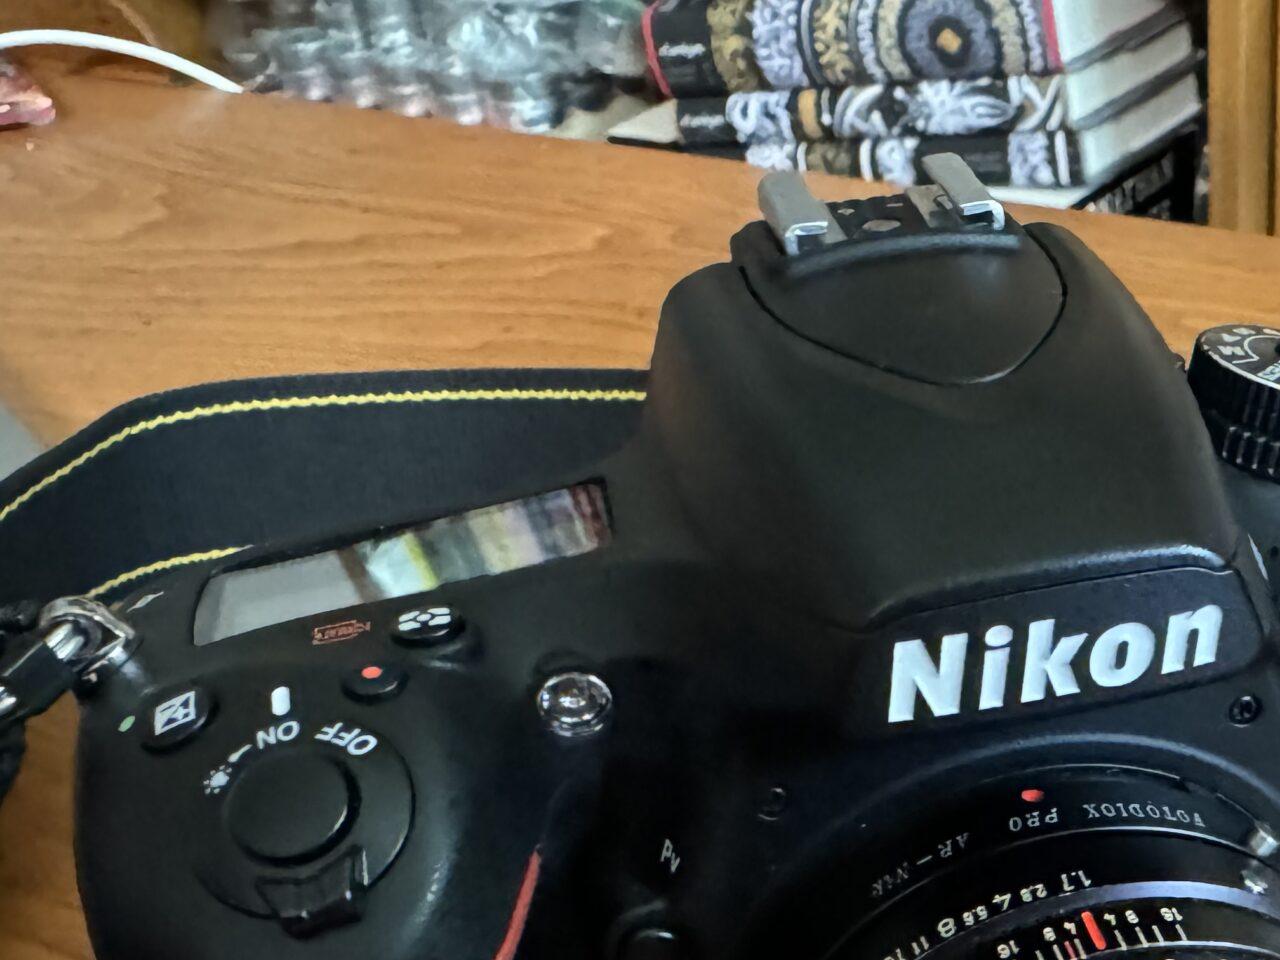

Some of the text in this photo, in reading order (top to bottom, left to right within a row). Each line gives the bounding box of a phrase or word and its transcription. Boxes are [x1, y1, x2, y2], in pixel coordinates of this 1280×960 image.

[887, 603, 1224, 723] Nikon
[256, 720, 300, 750] ON
[313, 722, 378, 755] OFF
[1009, 807, 1059, 832] PRO
[1083, 801, 1206, 827] FOTODIOX
[1061, 870, 1092, 892] 1.7
[992, 893, 1012, 911] 4
[962, 905, 989, 926] 5.6
[937, 917, 957, 938] 8
[911, 935, 930, 955] 11
[997, 939, 1020, 959] 16
